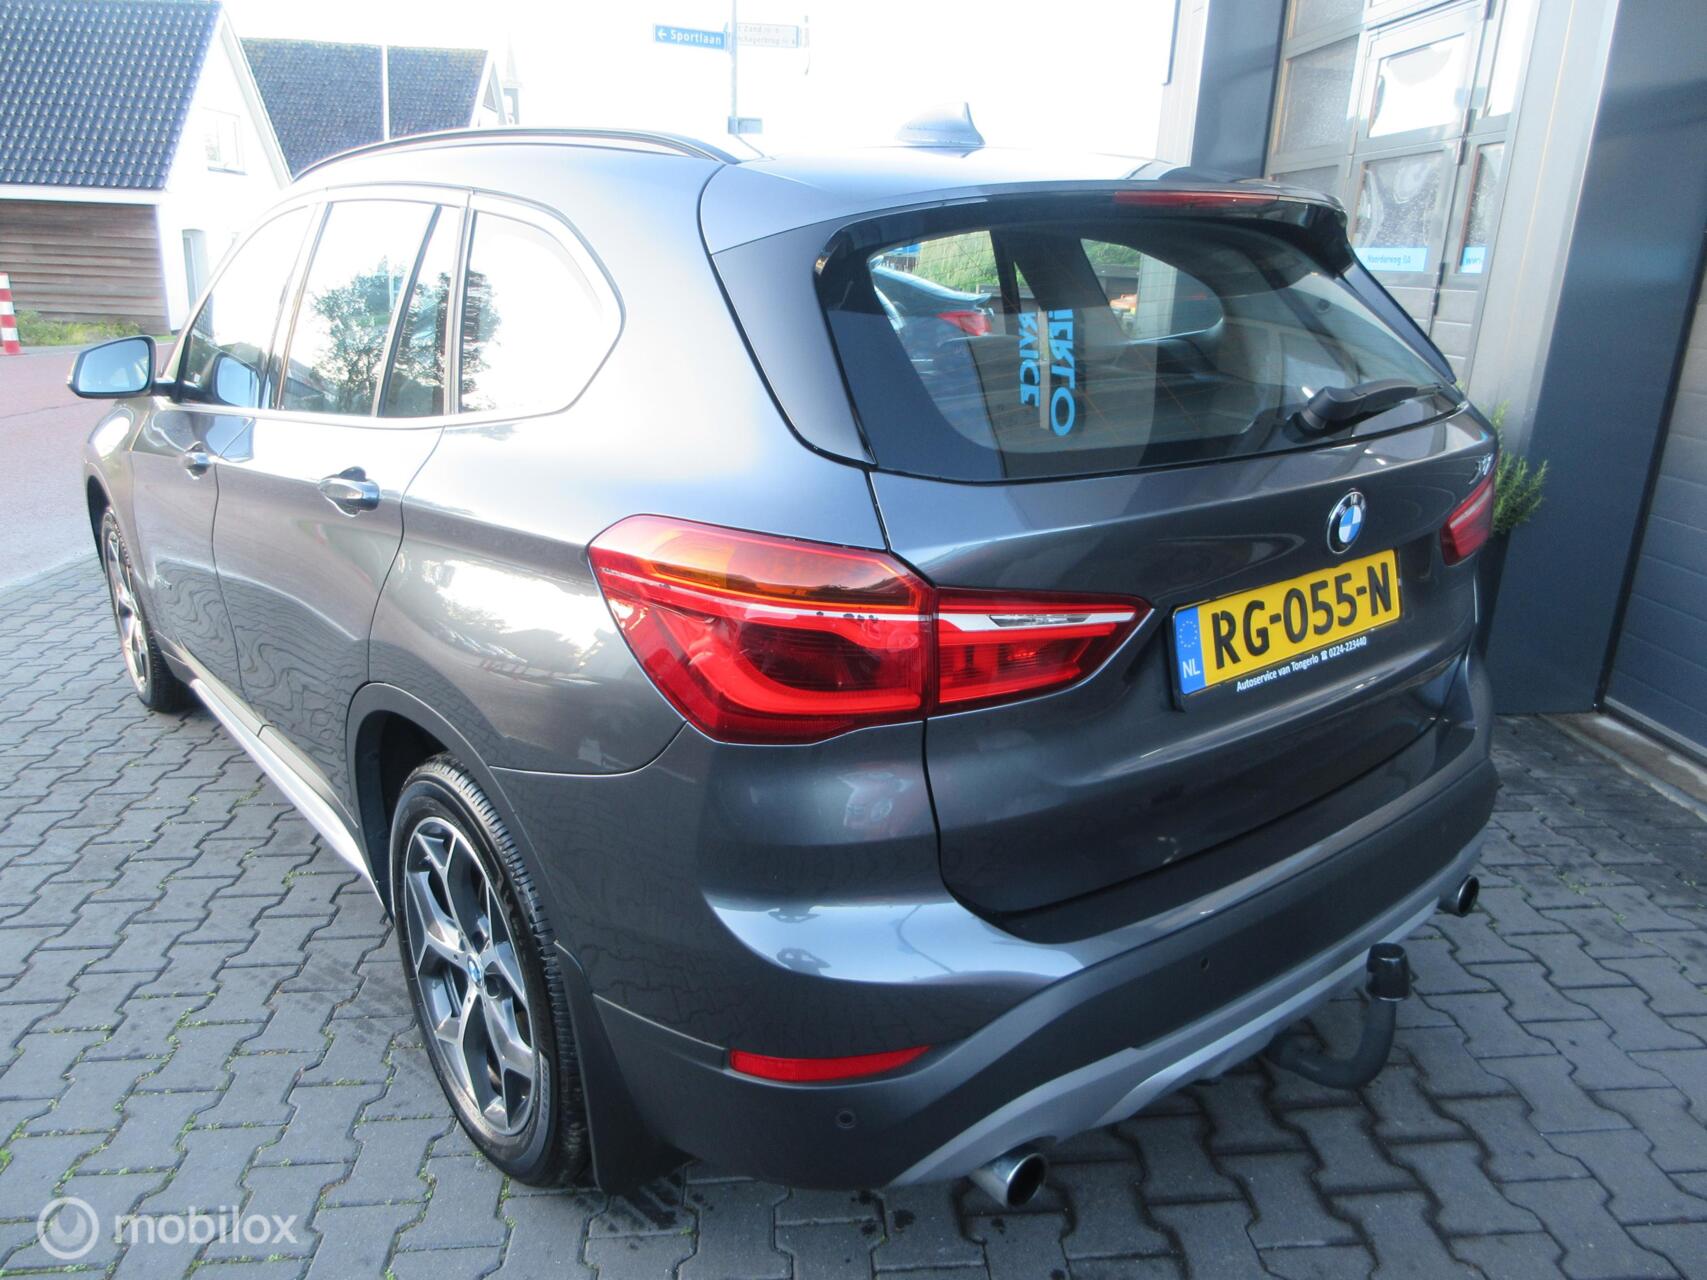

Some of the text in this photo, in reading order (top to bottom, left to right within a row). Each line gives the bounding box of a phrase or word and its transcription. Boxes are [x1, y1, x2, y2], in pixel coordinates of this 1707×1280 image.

[670, 29, 722, 46] Sportlaan
[1211, 562, 1393, 670] RG-055-N
[1182, 658, 1201, 679] NL
[1236, 635, 1368, 692] Autoservice van Tongerlo 0224-223440
